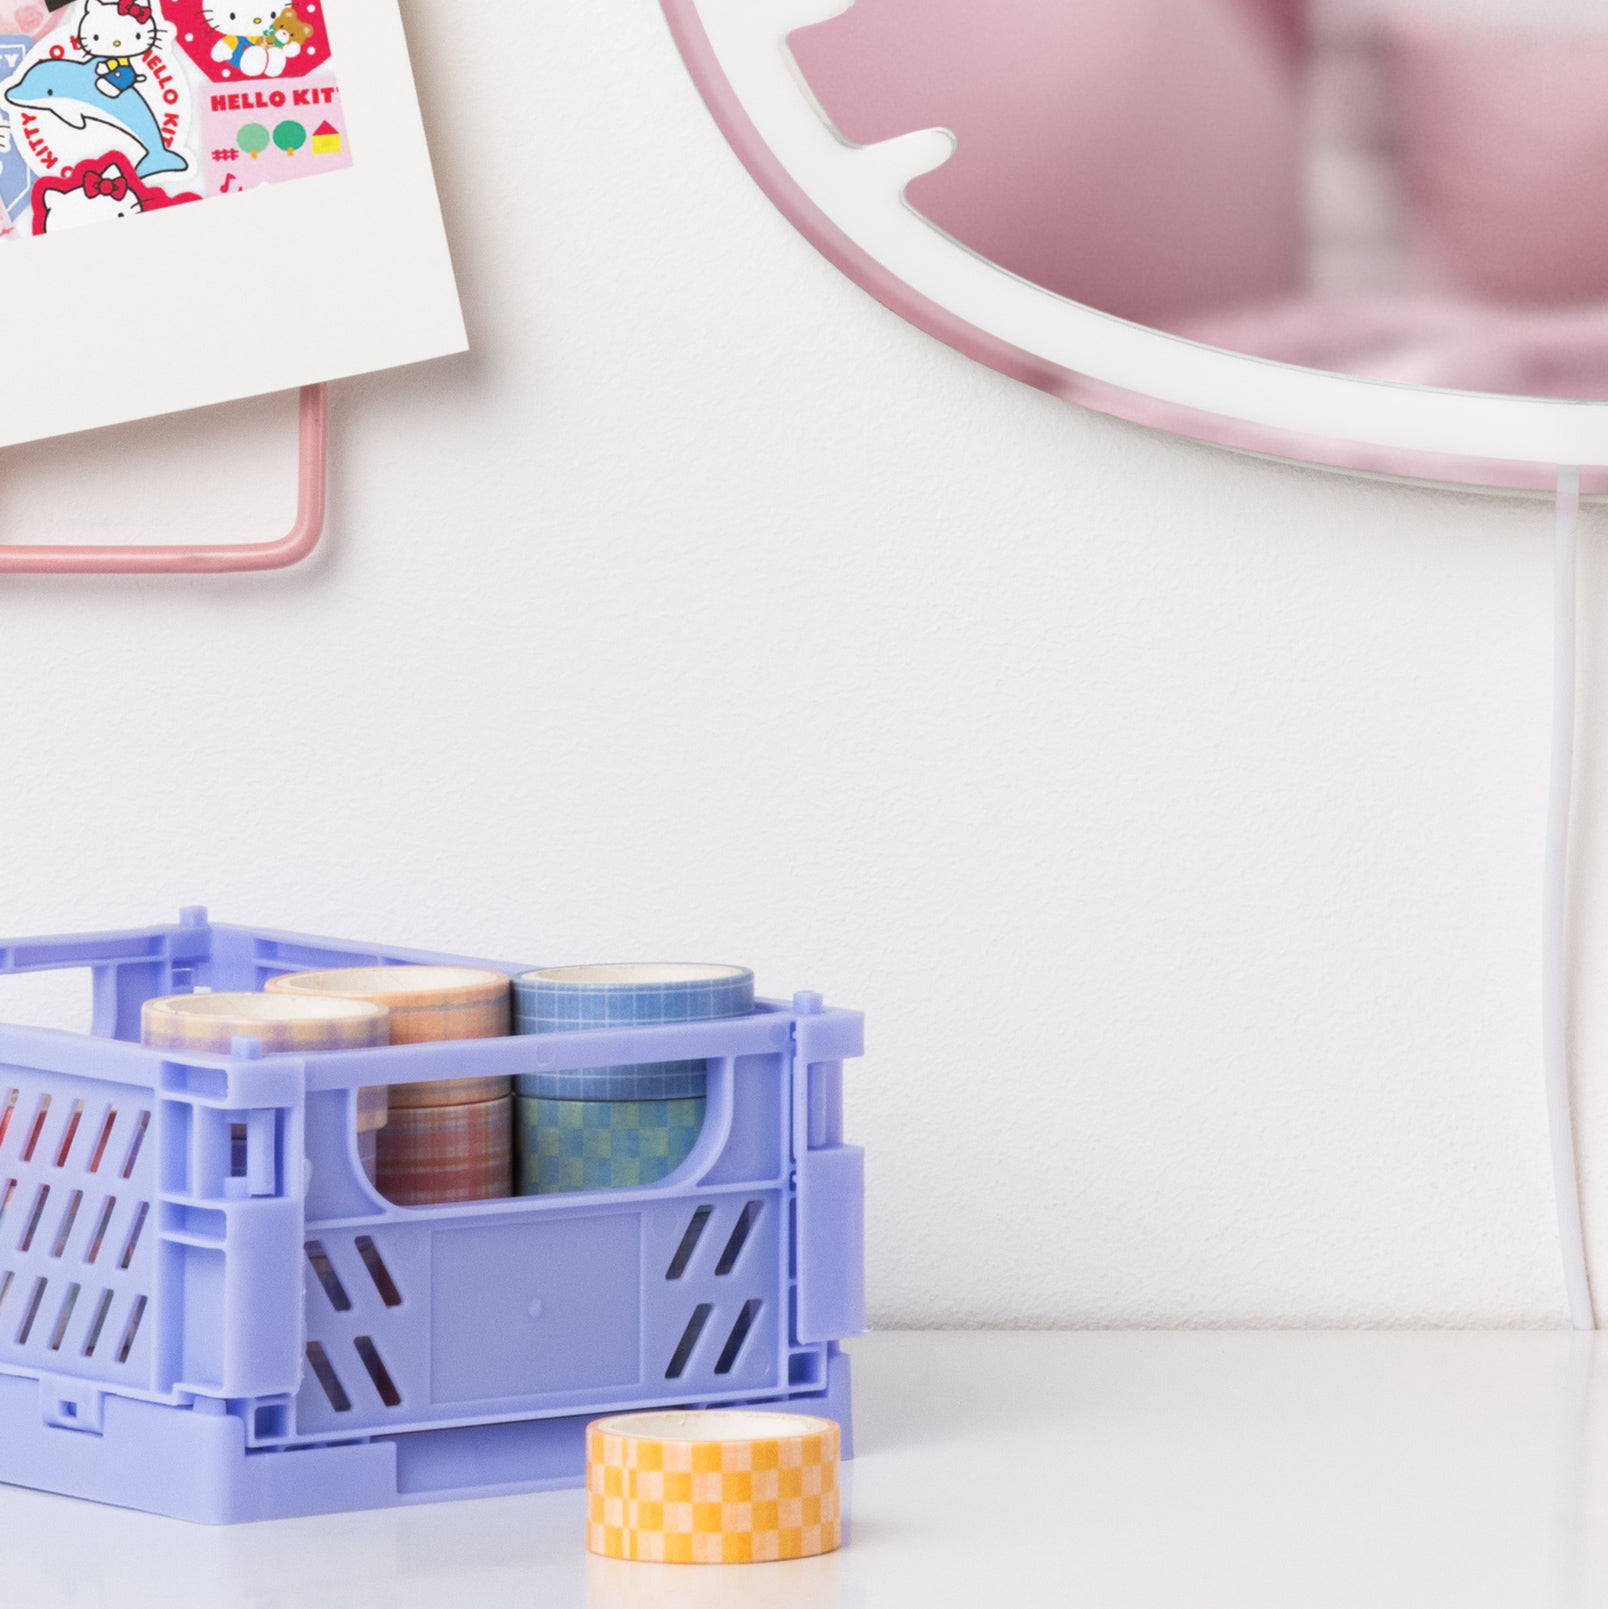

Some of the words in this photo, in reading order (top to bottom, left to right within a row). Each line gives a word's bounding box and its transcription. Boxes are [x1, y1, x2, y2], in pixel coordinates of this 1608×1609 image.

[210, 90, 286, 112] HELLO
[292, 87, 339, 106] KIT
[21, 112, 58, 169] KITTY
